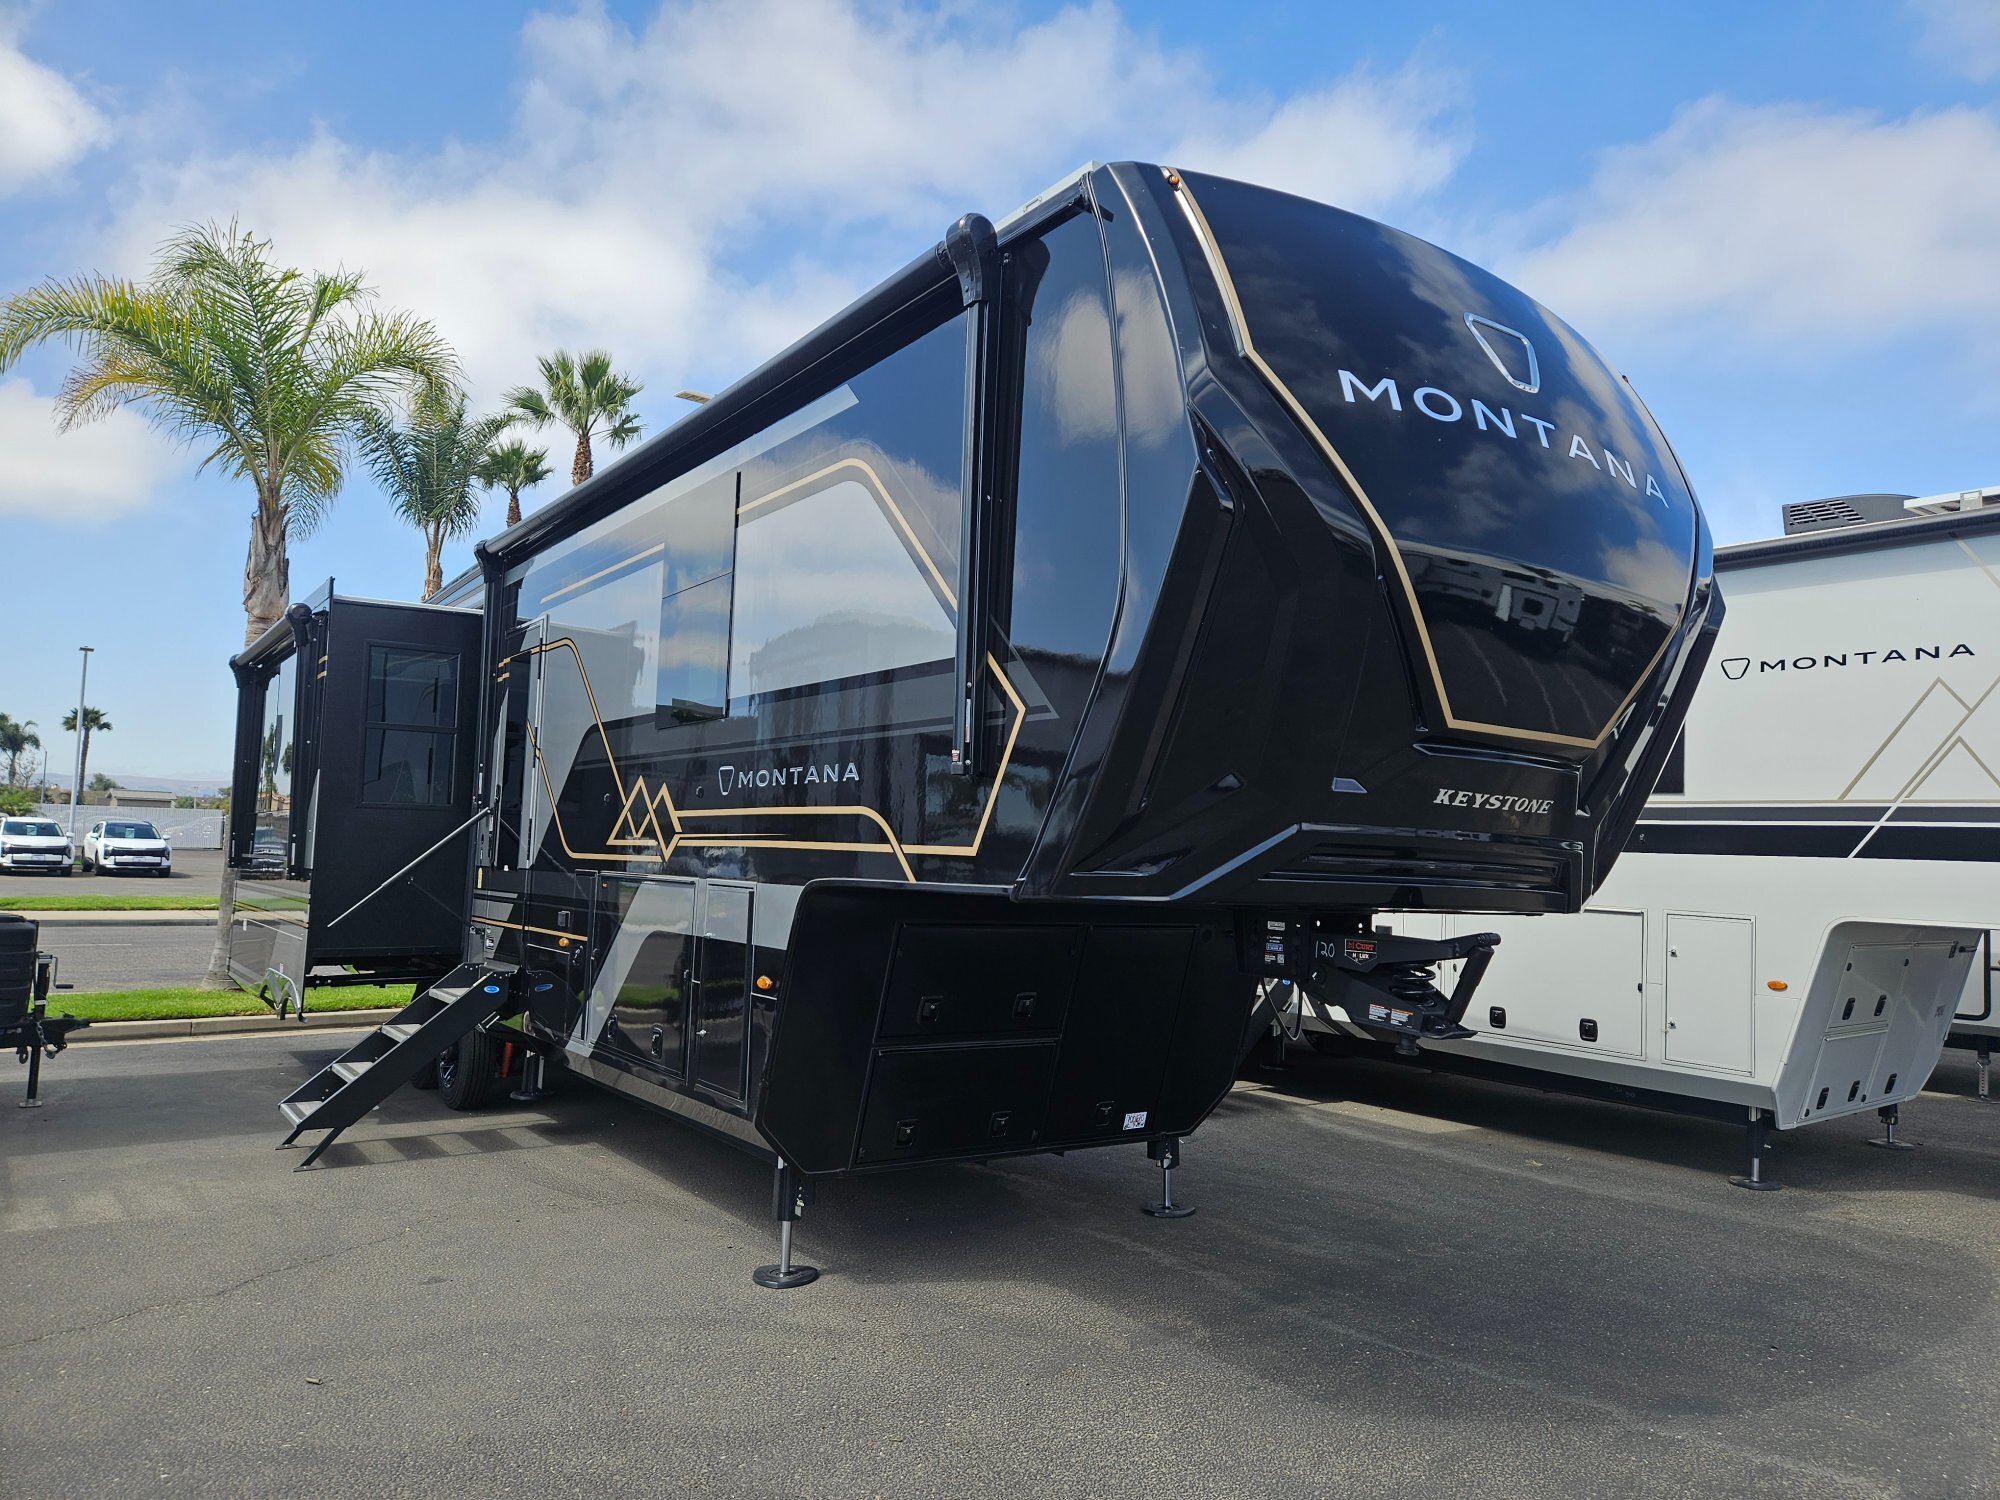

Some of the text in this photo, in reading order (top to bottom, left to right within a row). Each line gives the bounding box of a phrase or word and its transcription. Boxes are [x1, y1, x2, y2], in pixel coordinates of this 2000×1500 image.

[1337, 369, 1670, 509] MONTANA
[1760, 643, 1977, 673] MONTANA
[738, 762, 860, 789] MONTANA
[1432, 788, 1555, 814] KEYSTONE
[1315, 940, 1335, 959] 120
